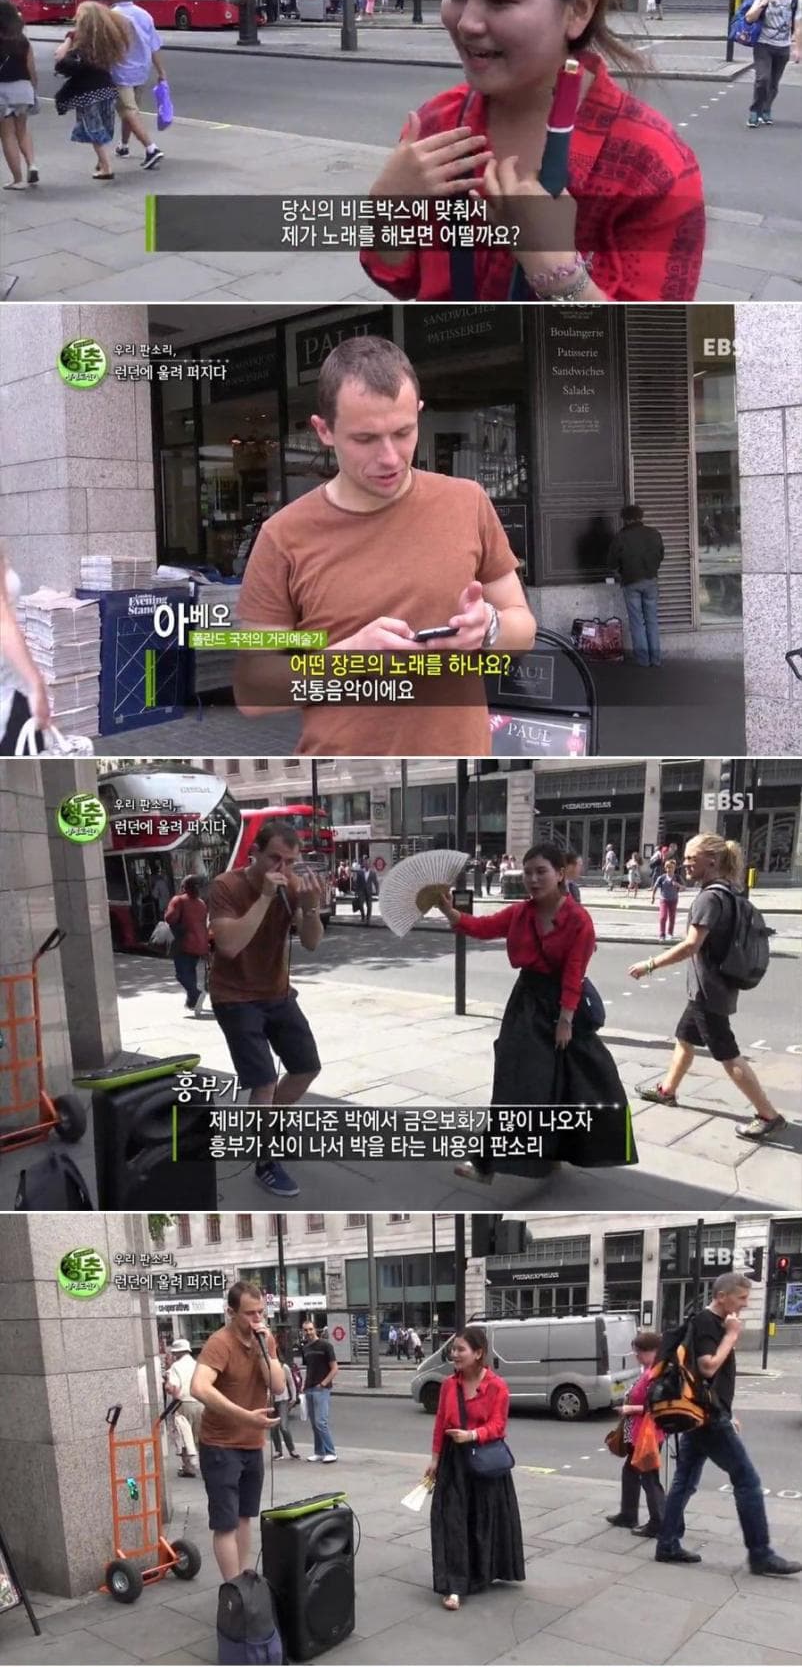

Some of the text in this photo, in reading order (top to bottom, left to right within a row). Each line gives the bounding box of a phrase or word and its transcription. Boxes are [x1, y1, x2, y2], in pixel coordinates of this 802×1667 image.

[550, 326, 604, 341] Boulangerie
[557, 346, 599, 359] Patisserie
[551, 365, 606, 377] Sandwiches
[562, 384, 595, 396] Salades
[569, 402, 590, 414] Café
[128, 595, 168, 609] Evening
[507, 723, 552, 743] PAUL
